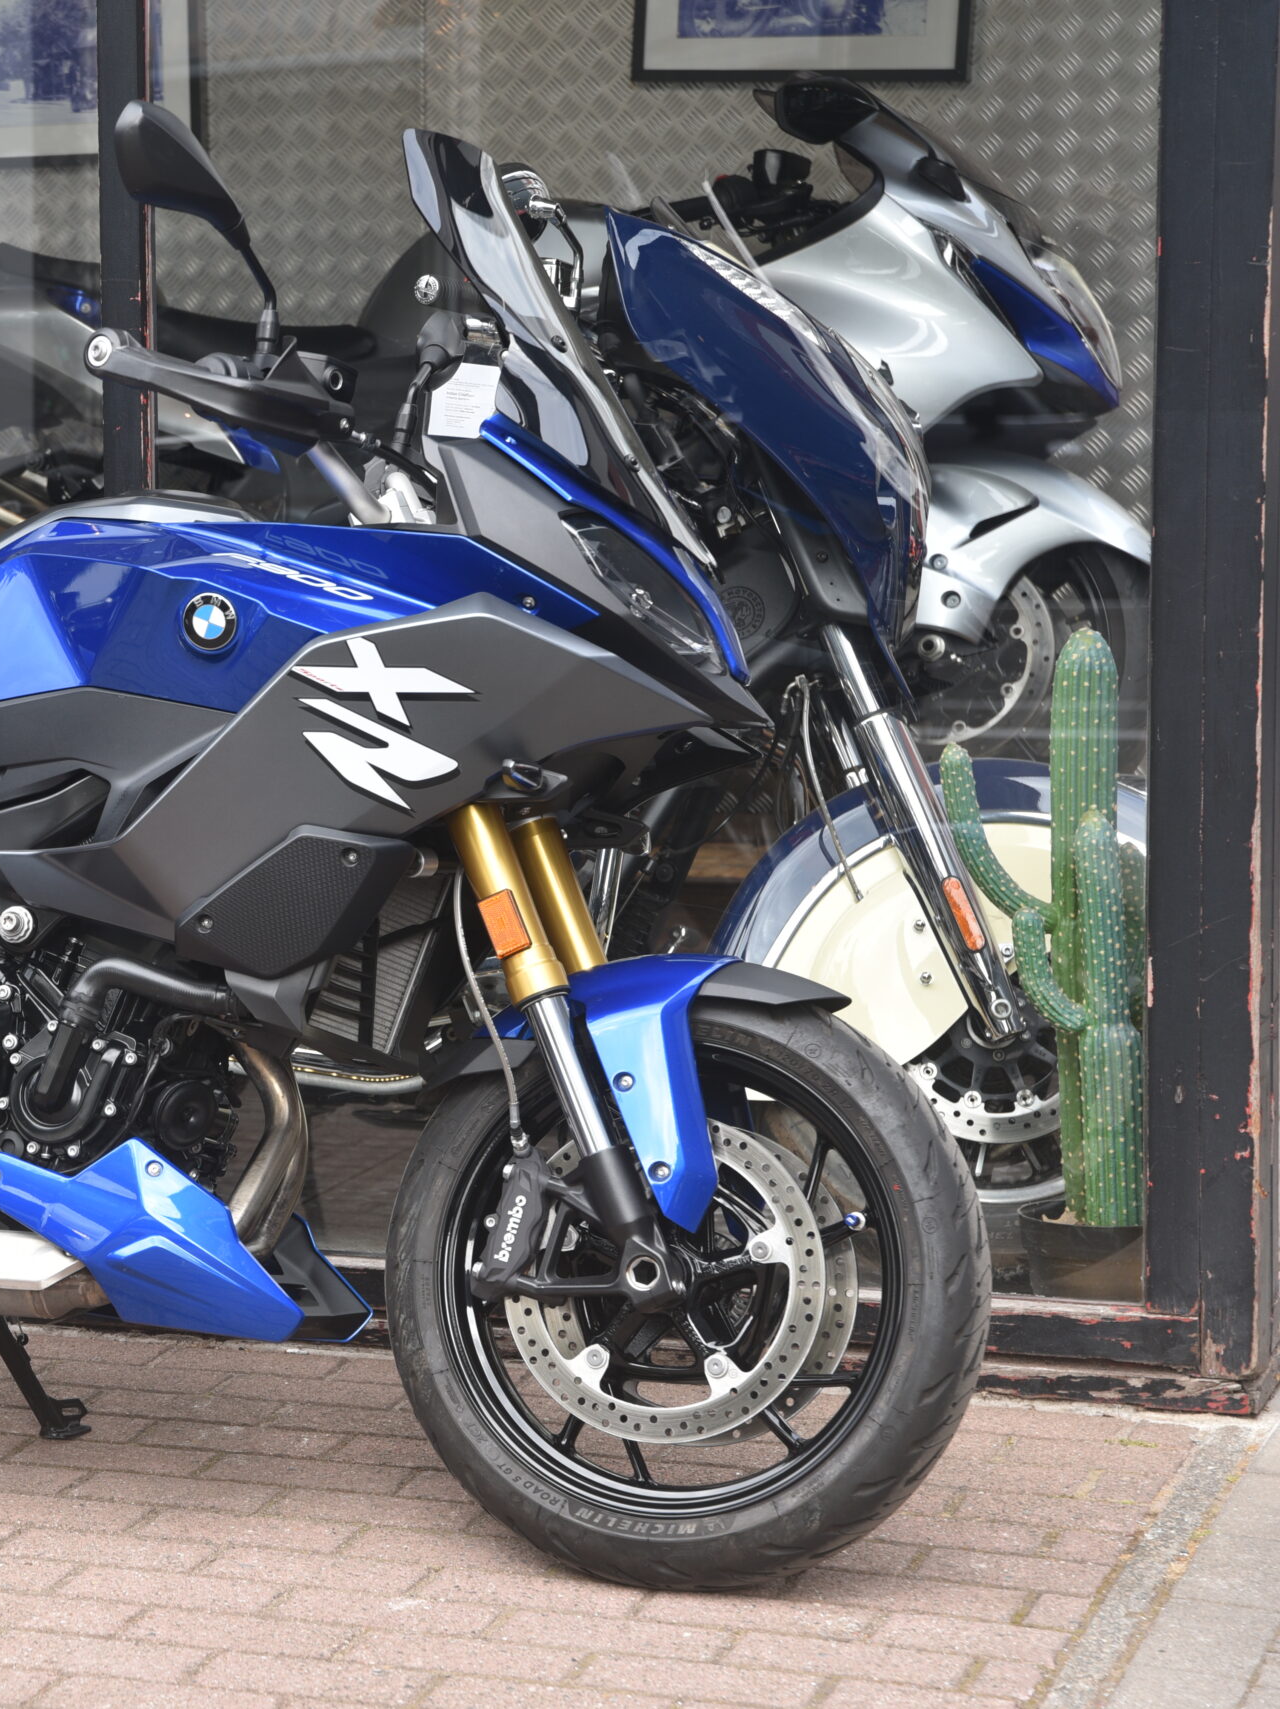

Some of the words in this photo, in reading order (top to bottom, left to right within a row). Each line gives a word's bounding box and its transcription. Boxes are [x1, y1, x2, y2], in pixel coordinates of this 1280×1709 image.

[493, 1194, 527, 1263] brembo
[496, 1461, 513, 1475] GT
[511, 1474, 521, 1483] 5
[522, 1479, 565, 1507] ROAD
[575, 1505, 697, 1535] MICHELIN
